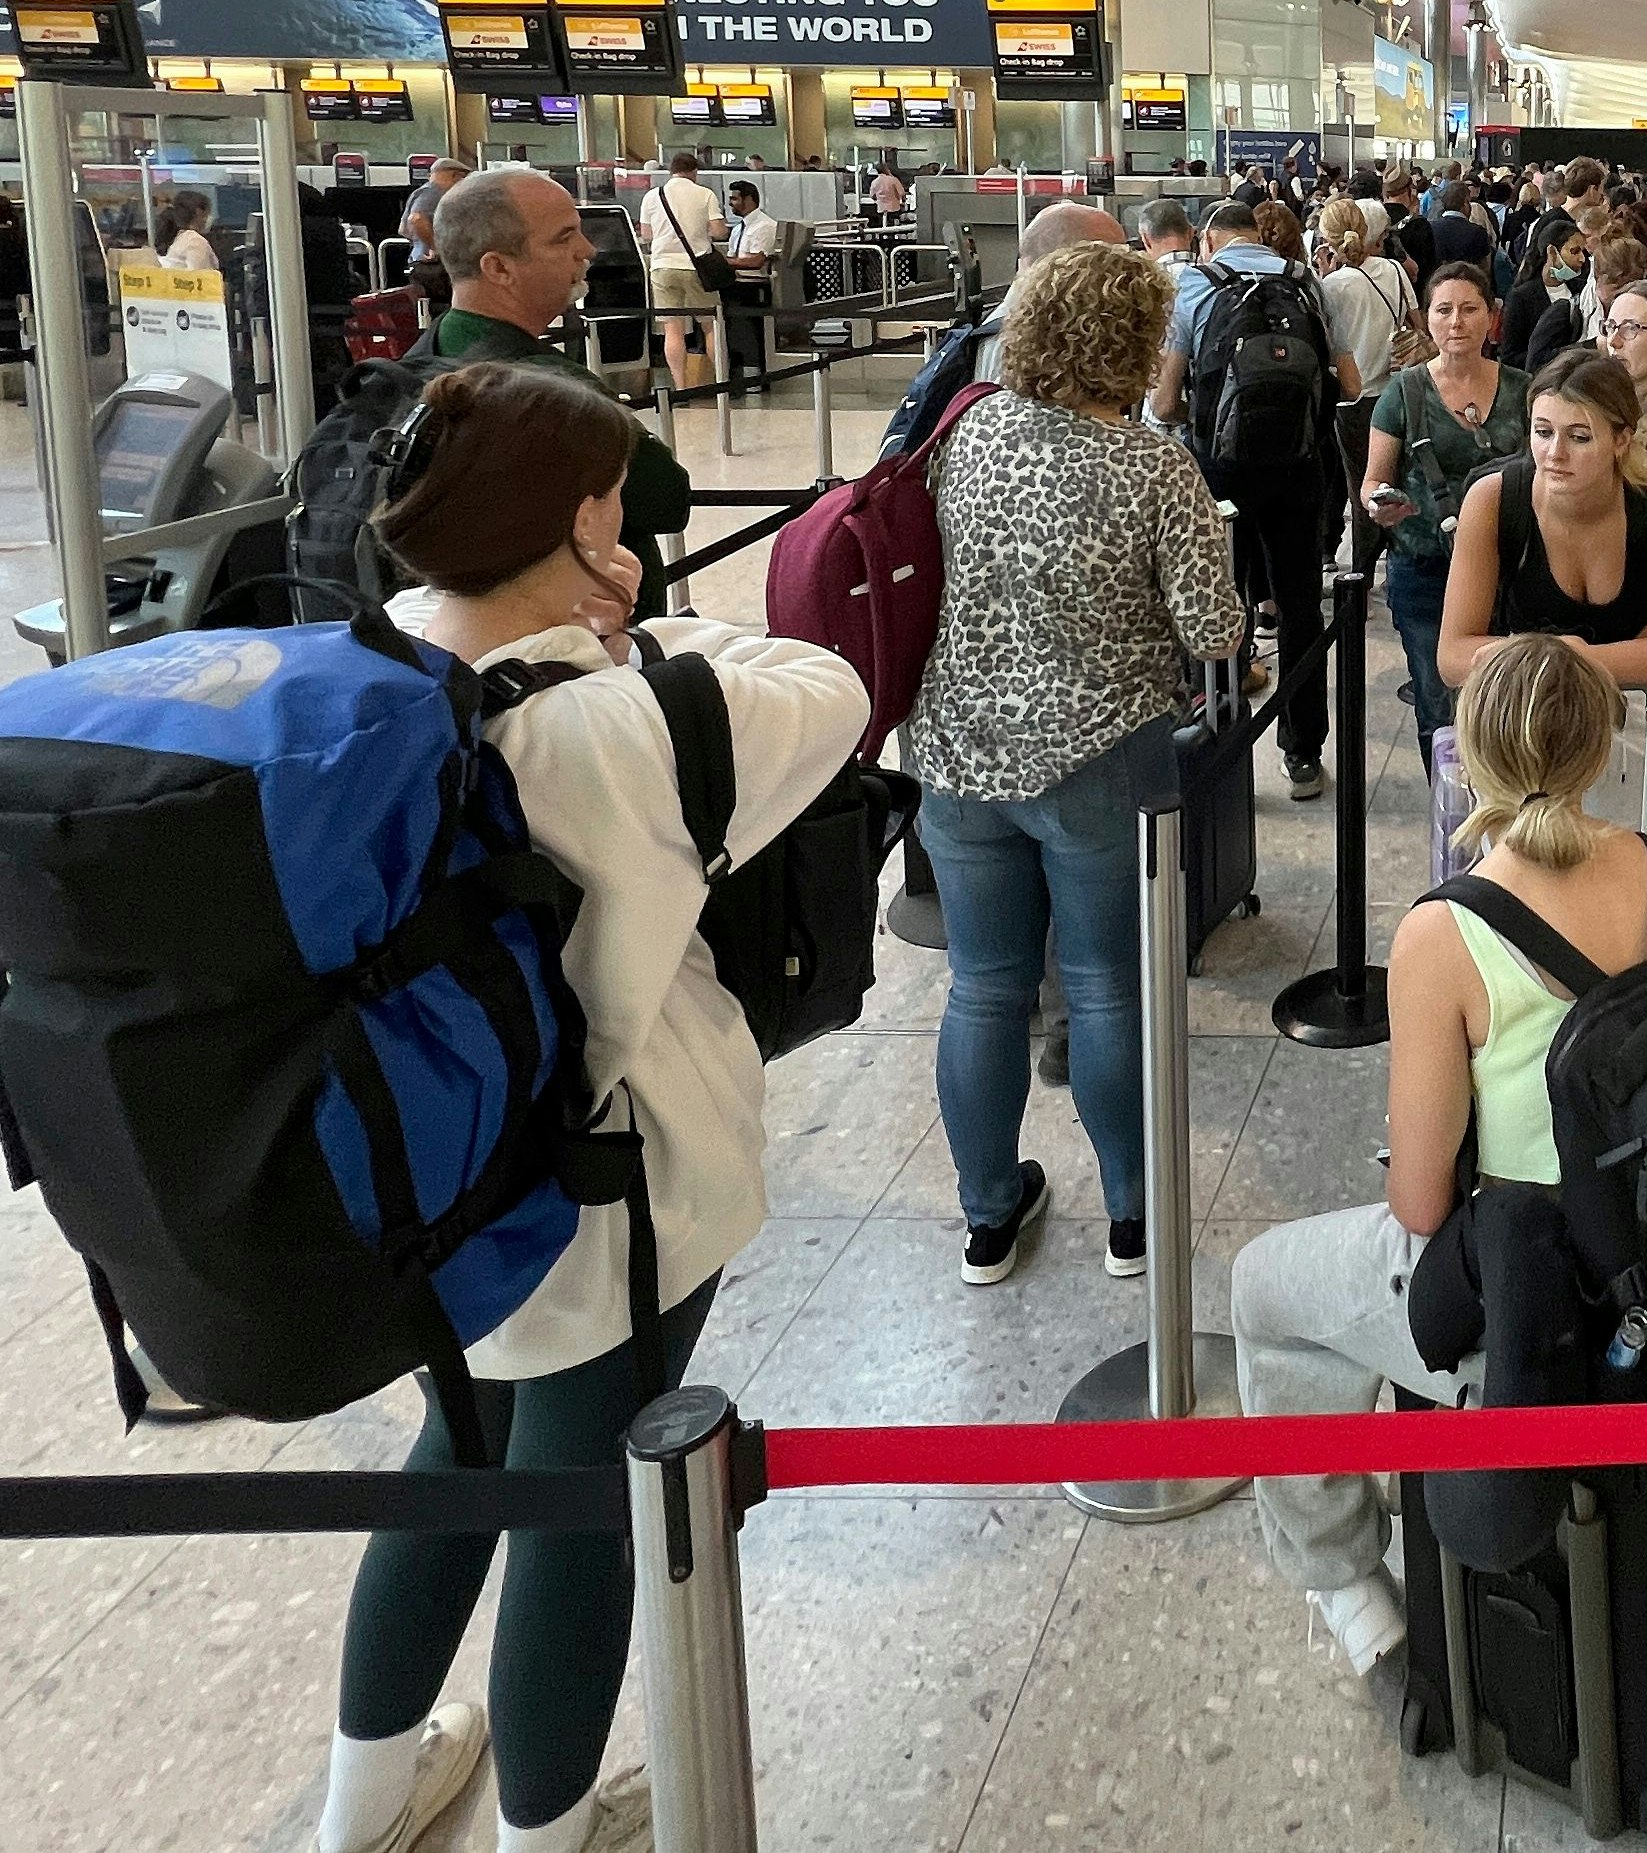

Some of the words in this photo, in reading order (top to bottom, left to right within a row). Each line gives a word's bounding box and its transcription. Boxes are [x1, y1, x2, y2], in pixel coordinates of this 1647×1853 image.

[698, 16, 778, 40] THE
[787, 18, 933, 43] WORLD
[1028, 42, 1056, 51] SWISS
